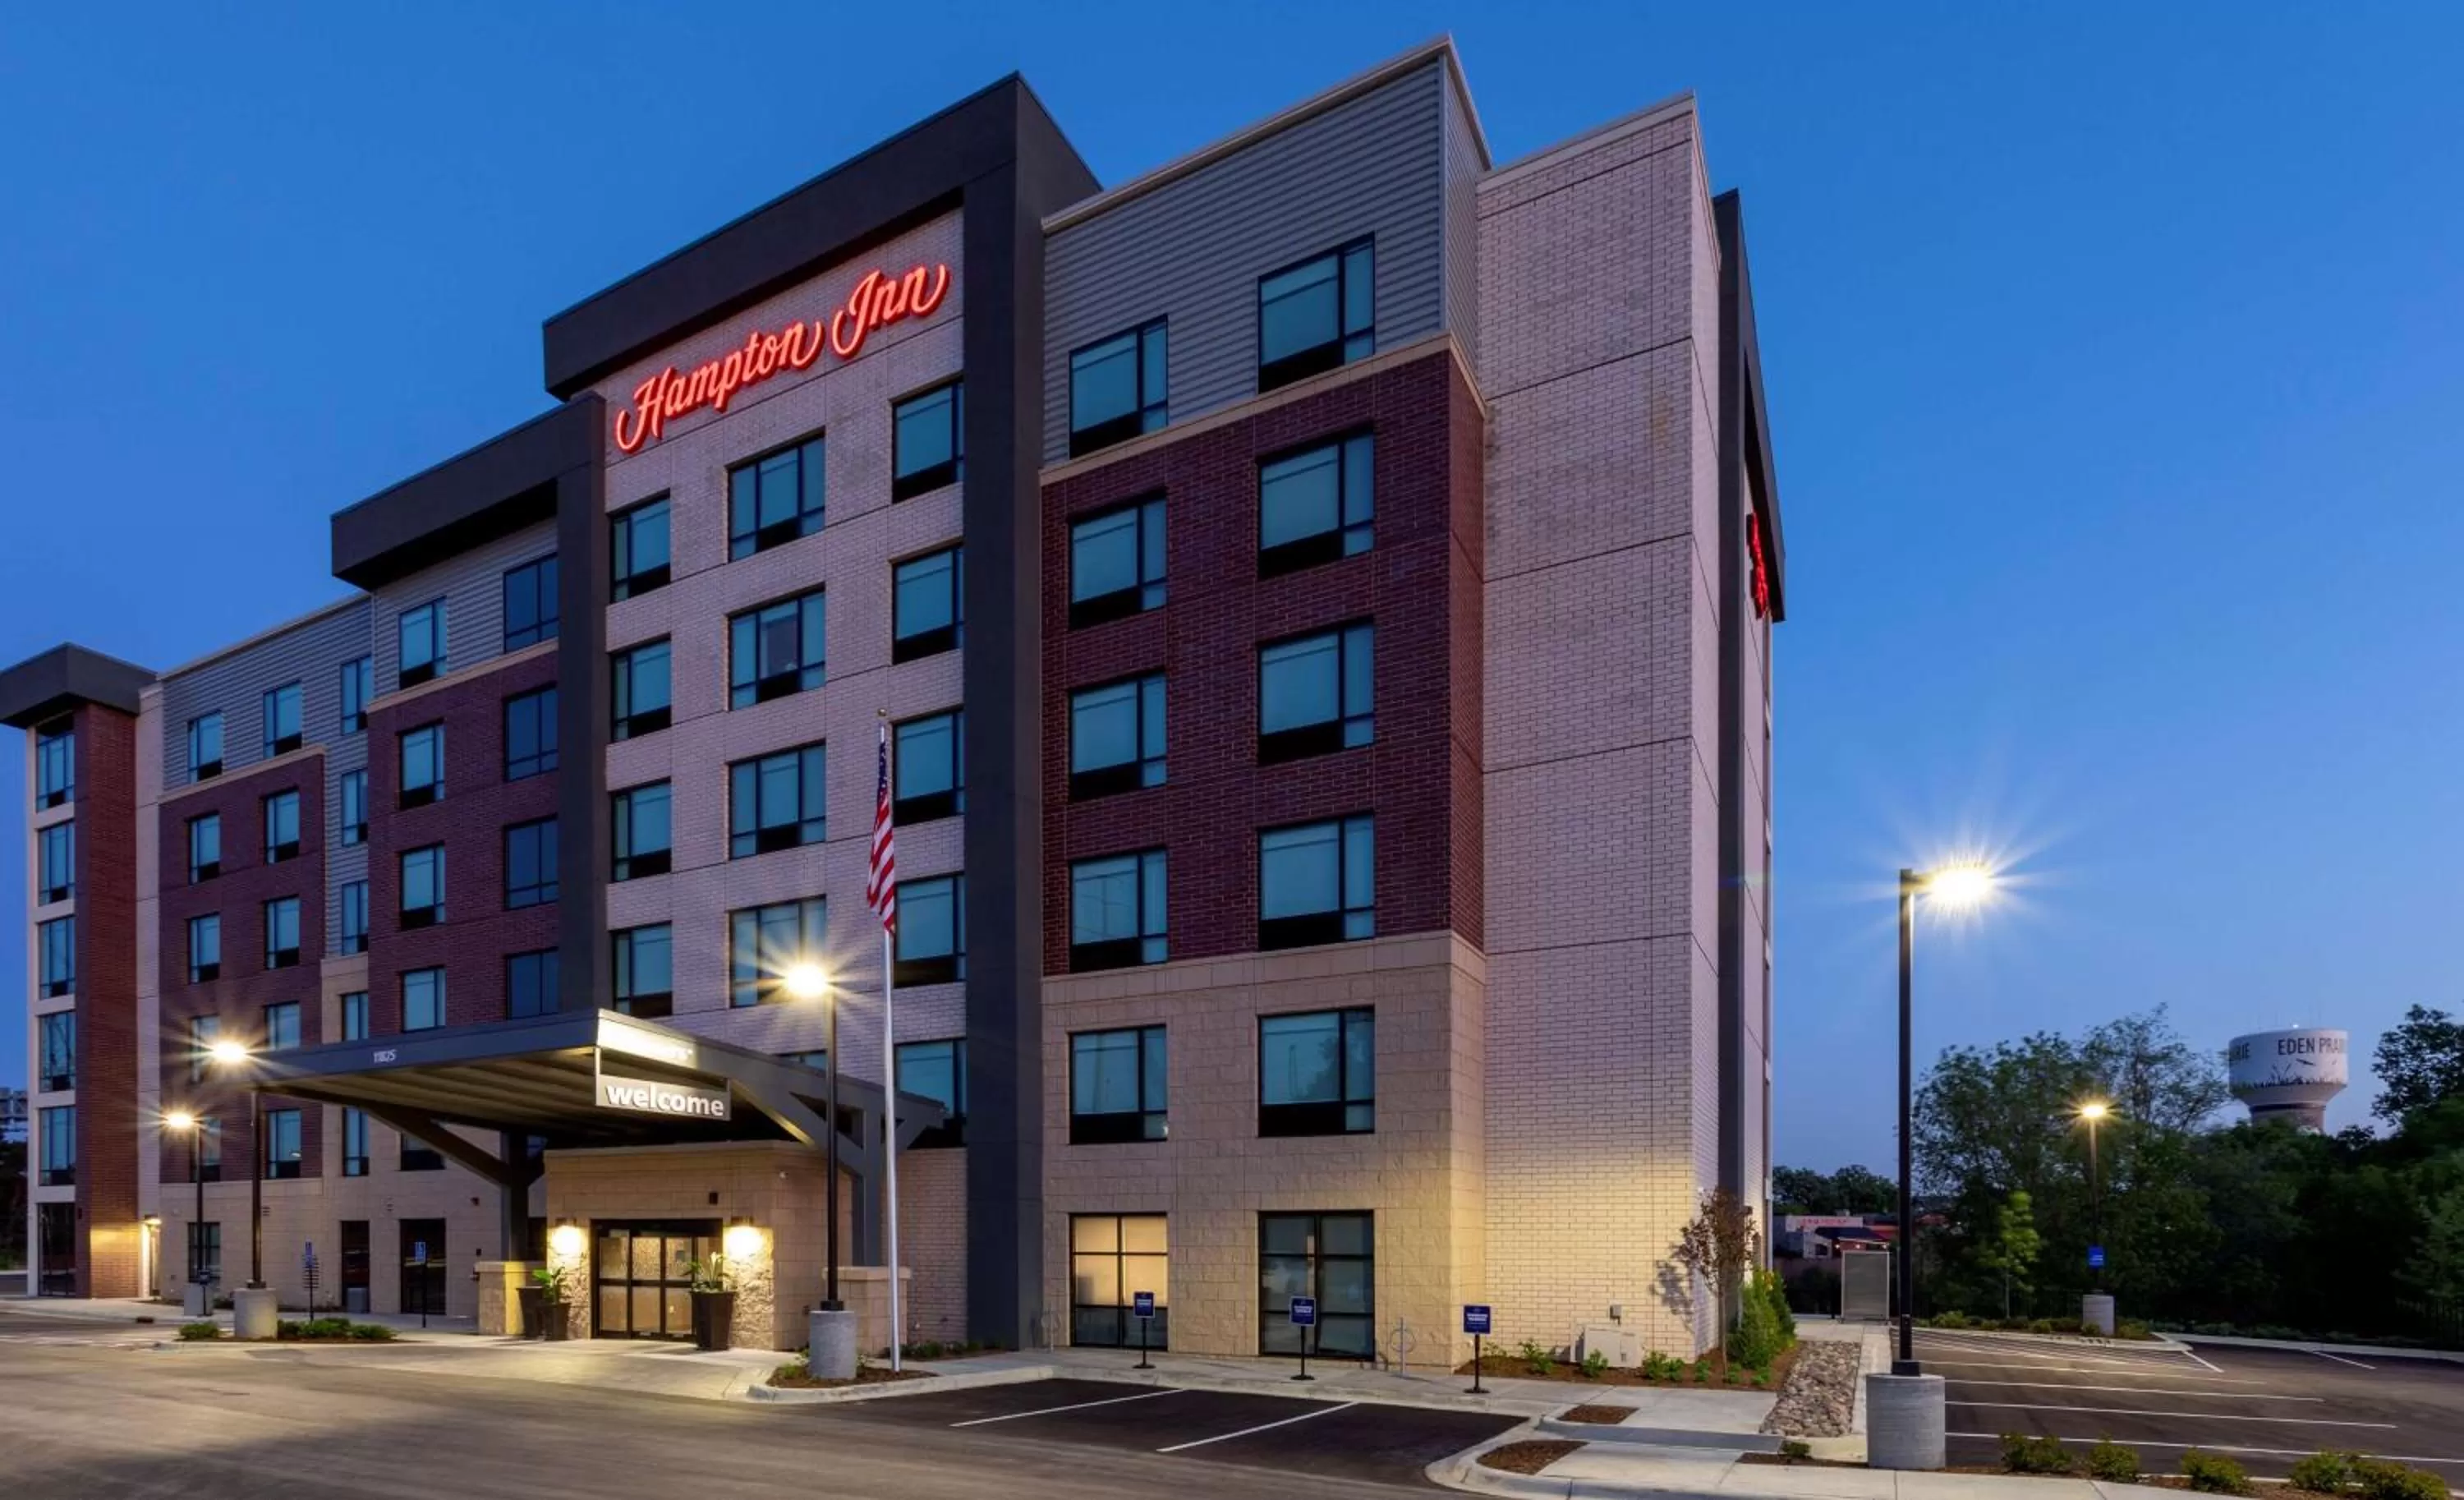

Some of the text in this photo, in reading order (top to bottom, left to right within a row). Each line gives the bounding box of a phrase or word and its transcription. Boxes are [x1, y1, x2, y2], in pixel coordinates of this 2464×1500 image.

[616, 262, 950, 453] Hampton Inn
[2278, 1038, 2315, 1055] EDEN
[605, 1084, 724, 1116] welcome
